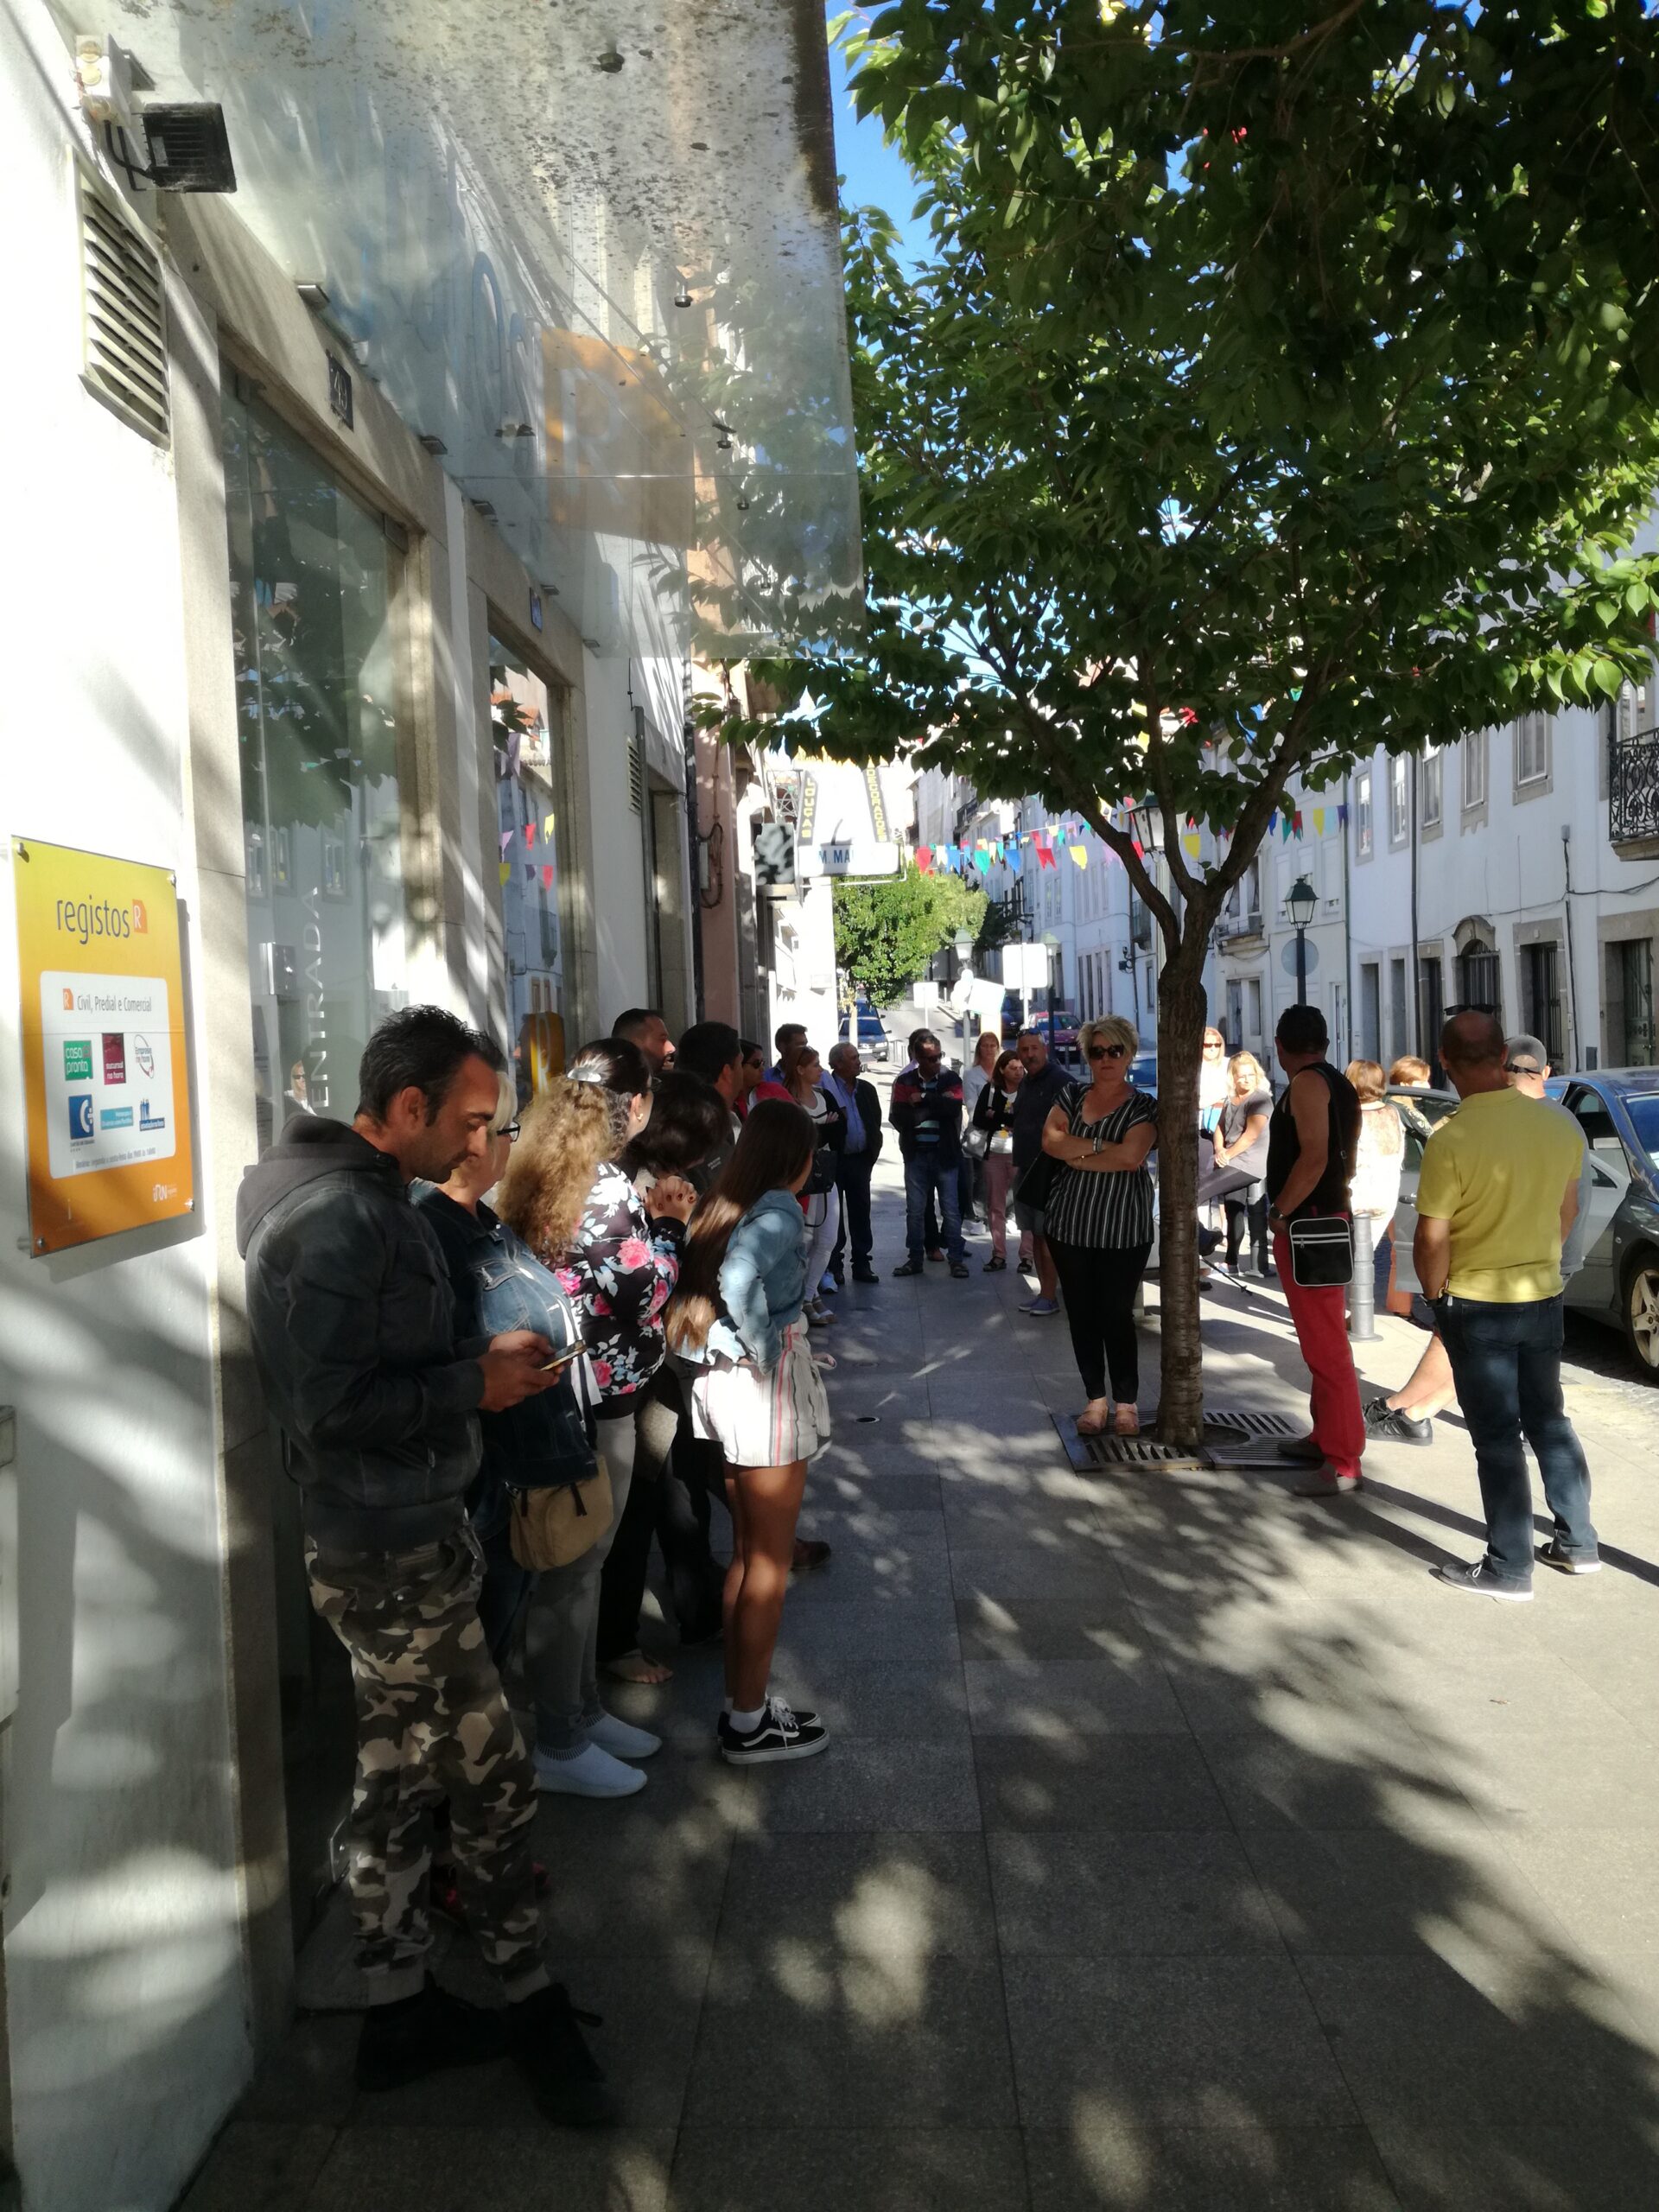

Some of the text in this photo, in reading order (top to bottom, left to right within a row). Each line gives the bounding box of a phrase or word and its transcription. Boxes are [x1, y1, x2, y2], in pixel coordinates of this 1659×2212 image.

[334, 370, 347, 411] 49
[56, 894, 130, 945] registos
[77, 994, 93, 1014] Civil,
[94, 995, 117, 1012] Predial
[118, 1001, 123, 1012] e
[124, 997, 152, 1012] Comercial
[301, 887, 329, 1108] ENTRADA
[65, 1046, 83, 1059] casa
[67, 1059, 89, 1075] pronta
